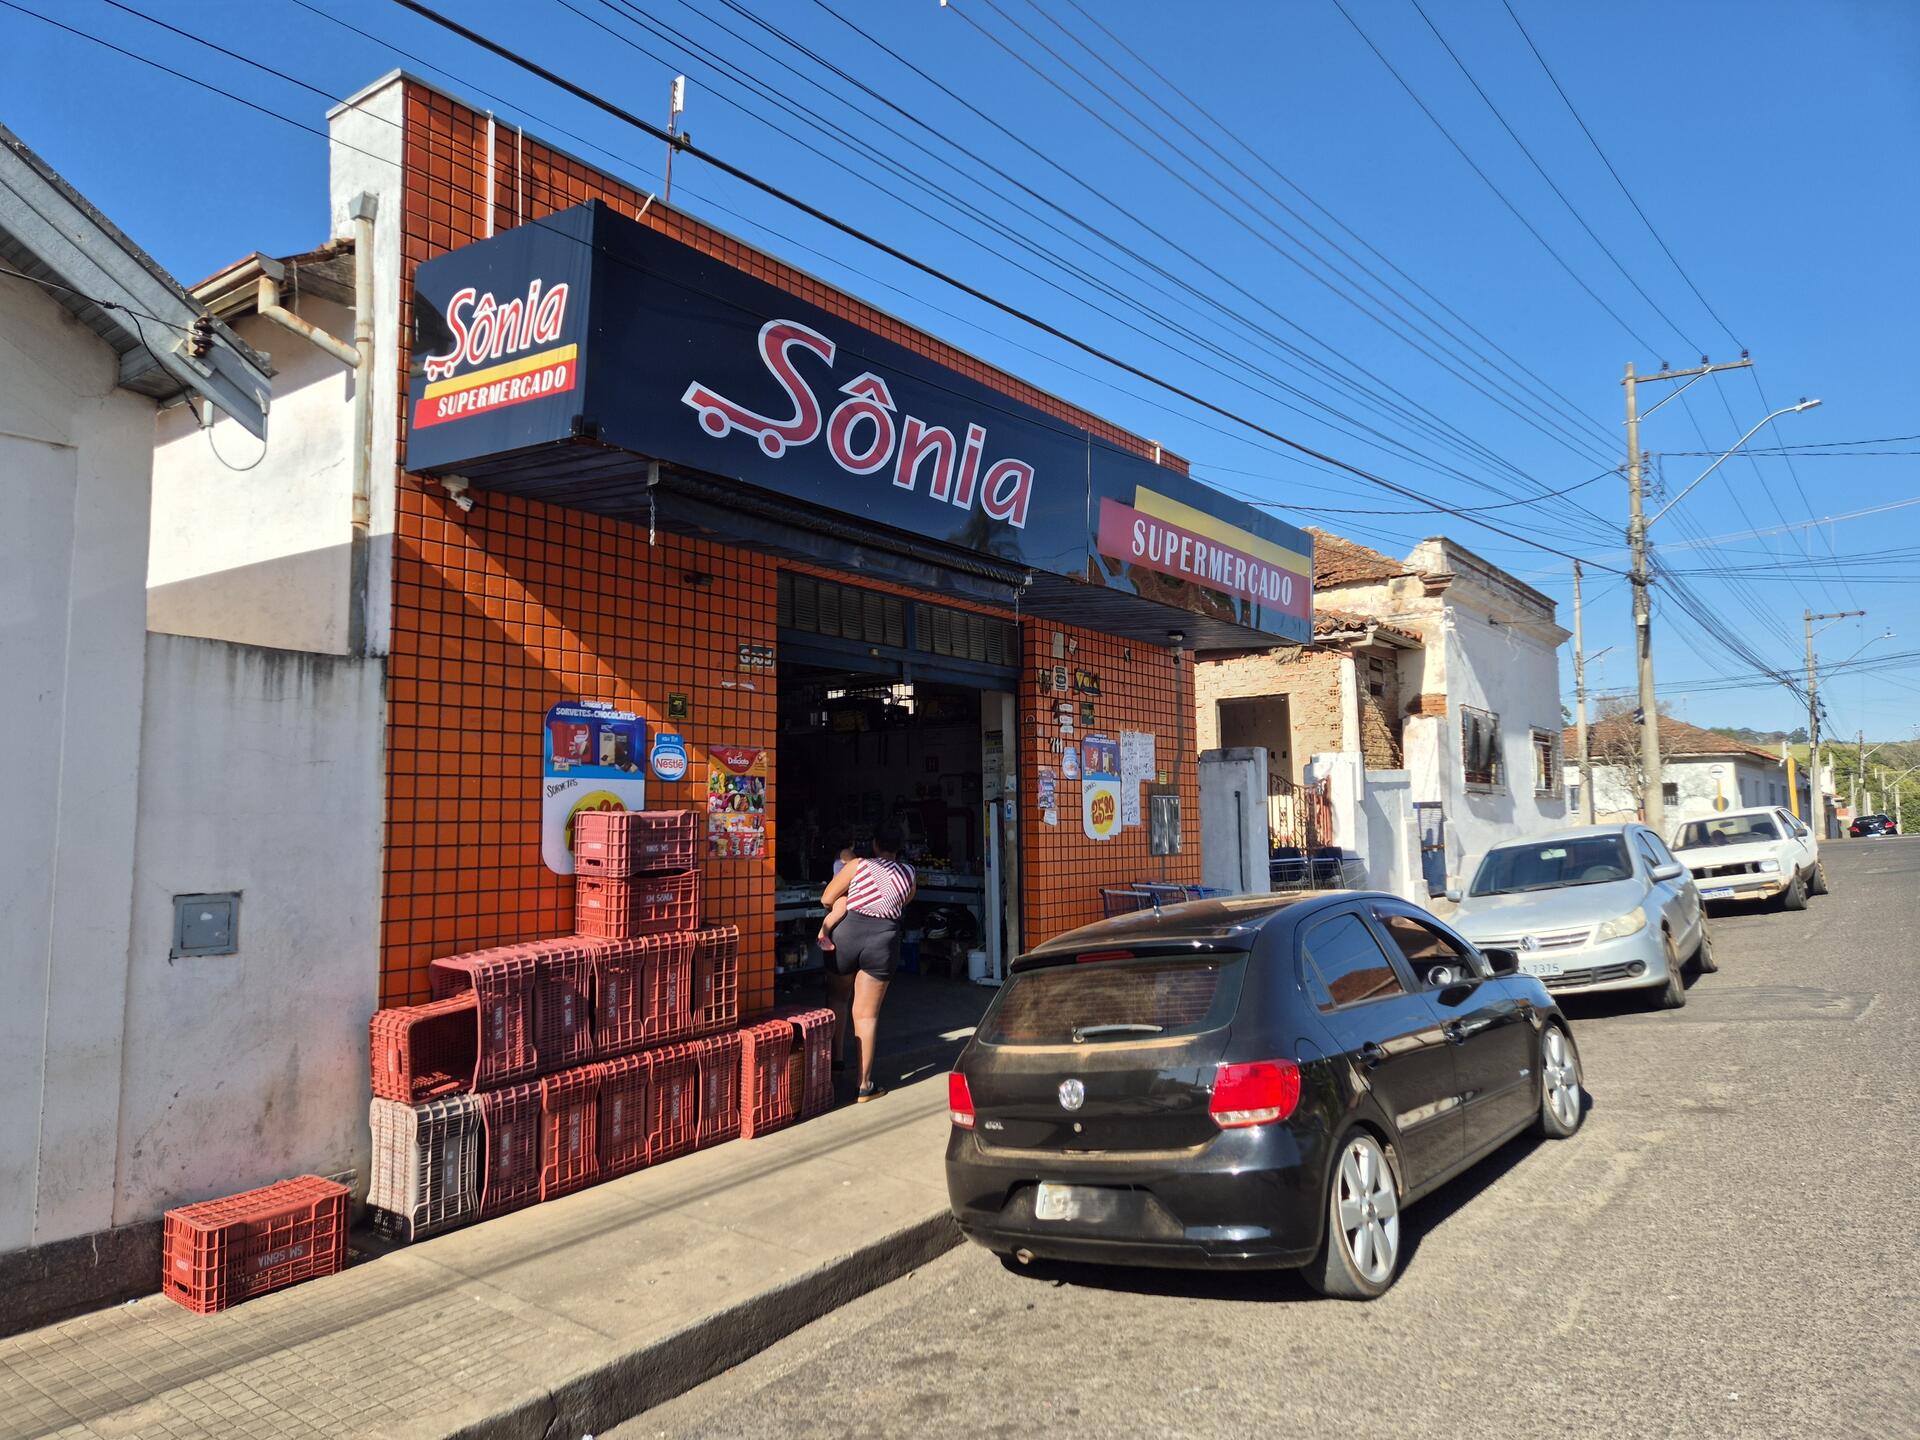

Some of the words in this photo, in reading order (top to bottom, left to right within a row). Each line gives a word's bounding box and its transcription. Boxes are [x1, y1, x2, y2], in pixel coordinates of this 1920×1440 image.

[424, 279, 568, 381] Sônia
[437, 365, 566, 417] SUPERMERCADO
[681, 318, 1035, 529] Sônia
[1132, 519, 1293, 606] SUPERMERCADO
[556, 708, 591, 717] SORVETES
[594, 711, 636, 720] CHOCOLATES
